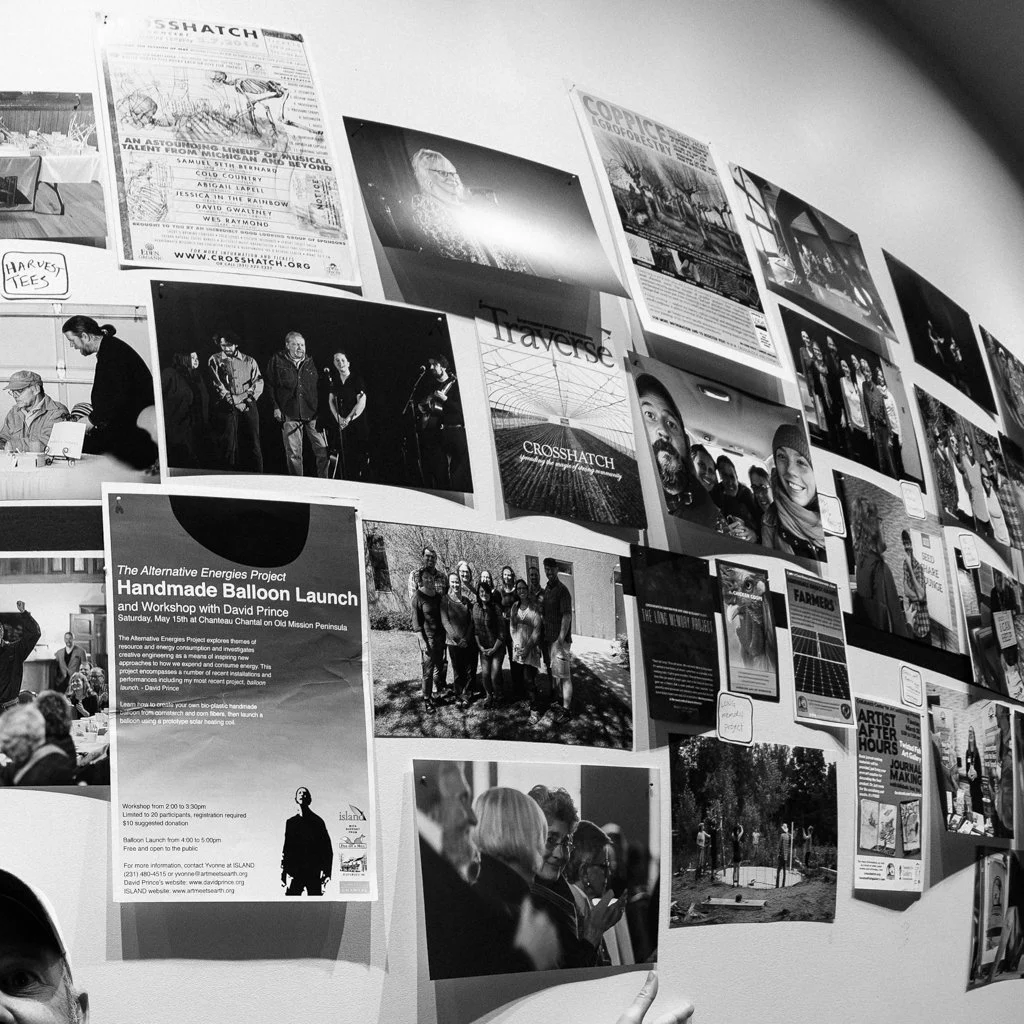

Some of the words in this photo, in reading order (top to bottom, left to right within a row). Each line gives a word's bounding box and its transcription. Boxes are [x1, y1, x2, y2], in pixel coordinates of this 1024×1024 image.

[583, 95, 668, 144] COPPICE
[592, 116, 672, 156] AGROFORESTRY
[121, 143, 160, 152] TALENT
[165, 147, 198, 156] FROM
[202, 150, 257, 163] MICHIGAN
[261, 156, 285, 166] AND
[288, 160, 332, 172] BEYOND
[145, 139, 219, 152] ASTOUNDING
[222, 146, 260, 156] LINEUP
[282, 153, 328, 164] MUSICAL
[177, 158, 210, 166] SAMUEL
[197, 182, 231, 191] ABIGAIL
[223, 173, 262, 182] COUNTRY
[313, 179, 323, 210] NOTICE
[225, 218, 269, 228] RAYMOND
[6, 259, 64, 278] HARVEST
[174, 252, 311, 270] WWW.CROSSHATCH.ORG
[6, 274, 50, 290] TEES
[479, 303, 615, 368] Traverse
[523, 440, 615, 470] CROSSHATCH
[117, 565, 138, 576] The
[140, 566, 197, 577] Alternative
[201, 568, 248, 580] Energies
[250, 570, 287, 582] Project
[117, 579, 218, 598] Handmade
[223, 583, 290, 601] Balloon
[296, 587, 358, 606] Launch
[794, 589, 835, 612] FARMERS
[117, 602, 138, 612] and
[141, 602, 196, 615] Workshop
[199, 603, 220, 614] with
[224, 604, 253, 615] David
[257, 605, 289, 617] Prince
[117, 614, 153, 623] Saturday,
[154, 615, 170, 624] May
[198, 617, 233, 625] Chanteau
[235, 618, 262, 626] Chantal
[274, 619, 286, 627] Old
[288, 620, 314, 629] Mission
[315, 622, 348, 631] Peninsula
[642, 608, 653, 623] THE
[655, 611, 668, 625] LONG
[670, 614, 690, 629] MEMORY
[691, 617, 713, 634] PROJECT
[857, 708, 896, 727] ARTIST
[858, 723, 897, 741] AFTER
[858, 737, 898, 755] HOURS
[890, 759, 922, 774] JOURNAL
[890, 770, 922, 785] MAKING
[339, 811, 364, 821] island
